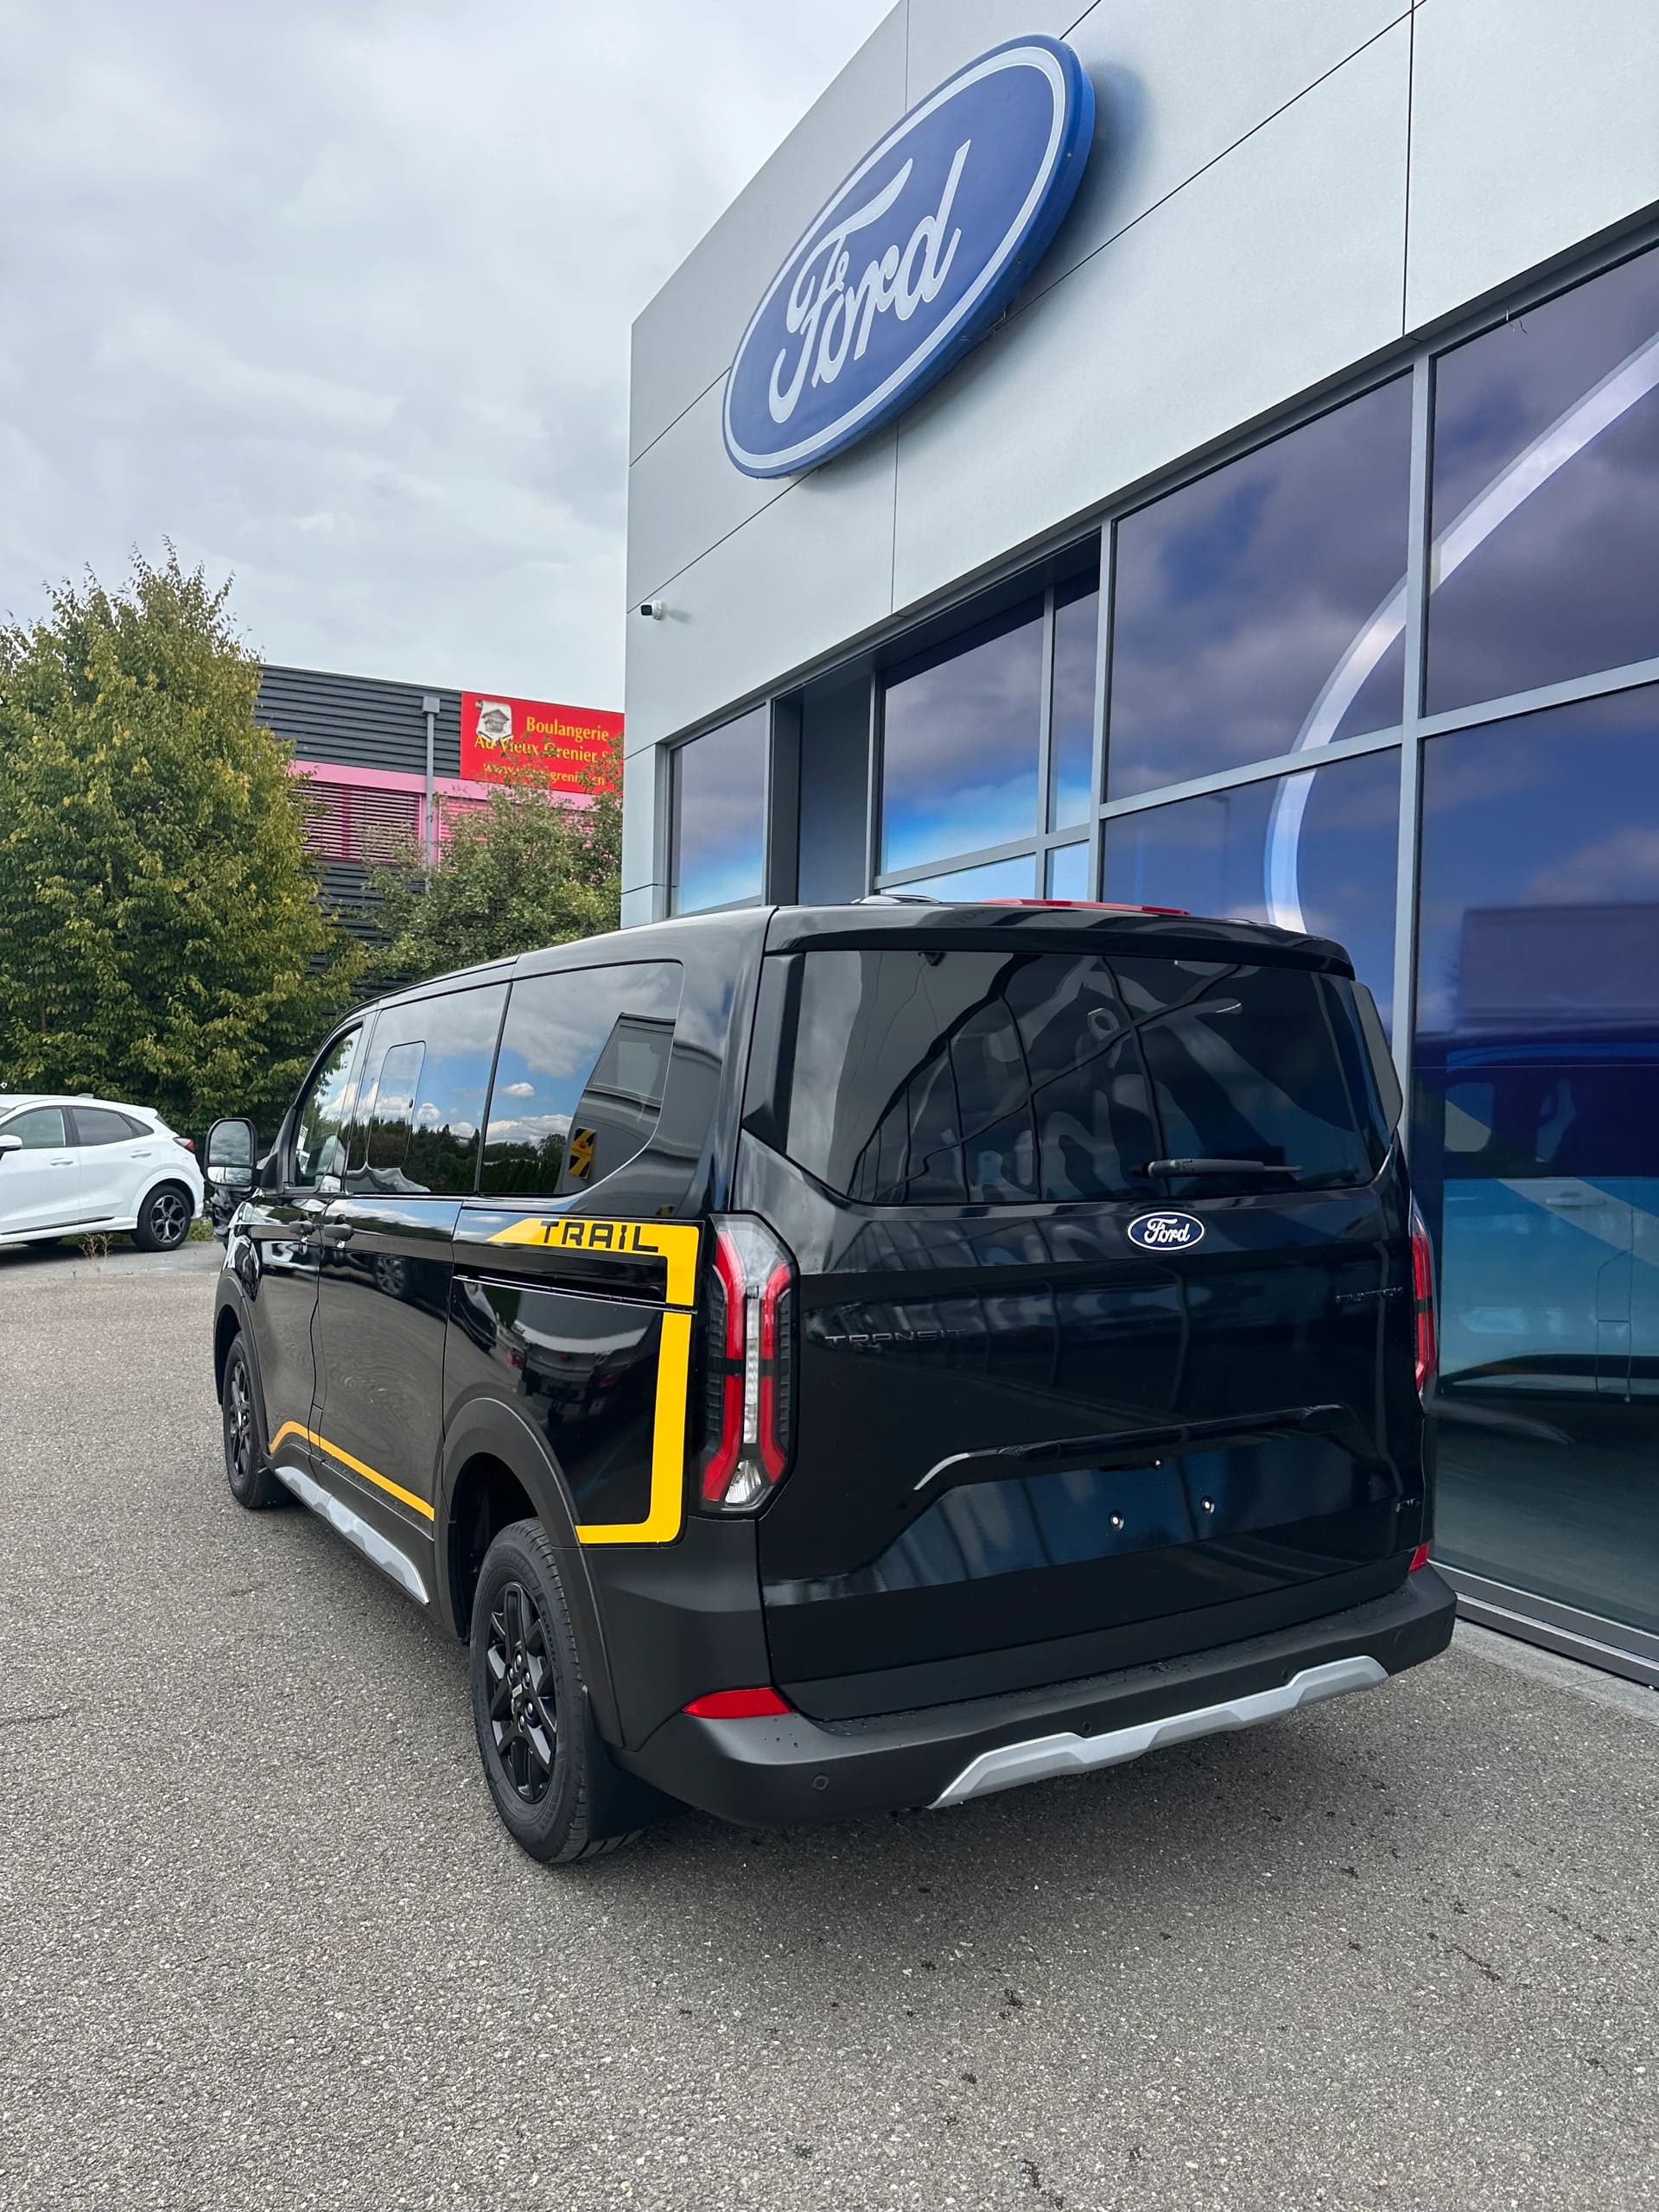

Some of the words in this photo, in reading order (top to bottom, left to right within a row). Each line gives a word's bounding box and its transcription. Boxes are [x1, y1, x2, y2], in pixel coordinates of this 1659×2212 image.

[769, 139, 971, 423] Ford
[525, 715, 609, 743] Boulangerie
[474, 734, 495, 750] Au
[499, 736, 539, 756] Vieux
[540, 1220, 659, 1254] TRAIL
[1143, 1217, 1191, 1243] Ford
